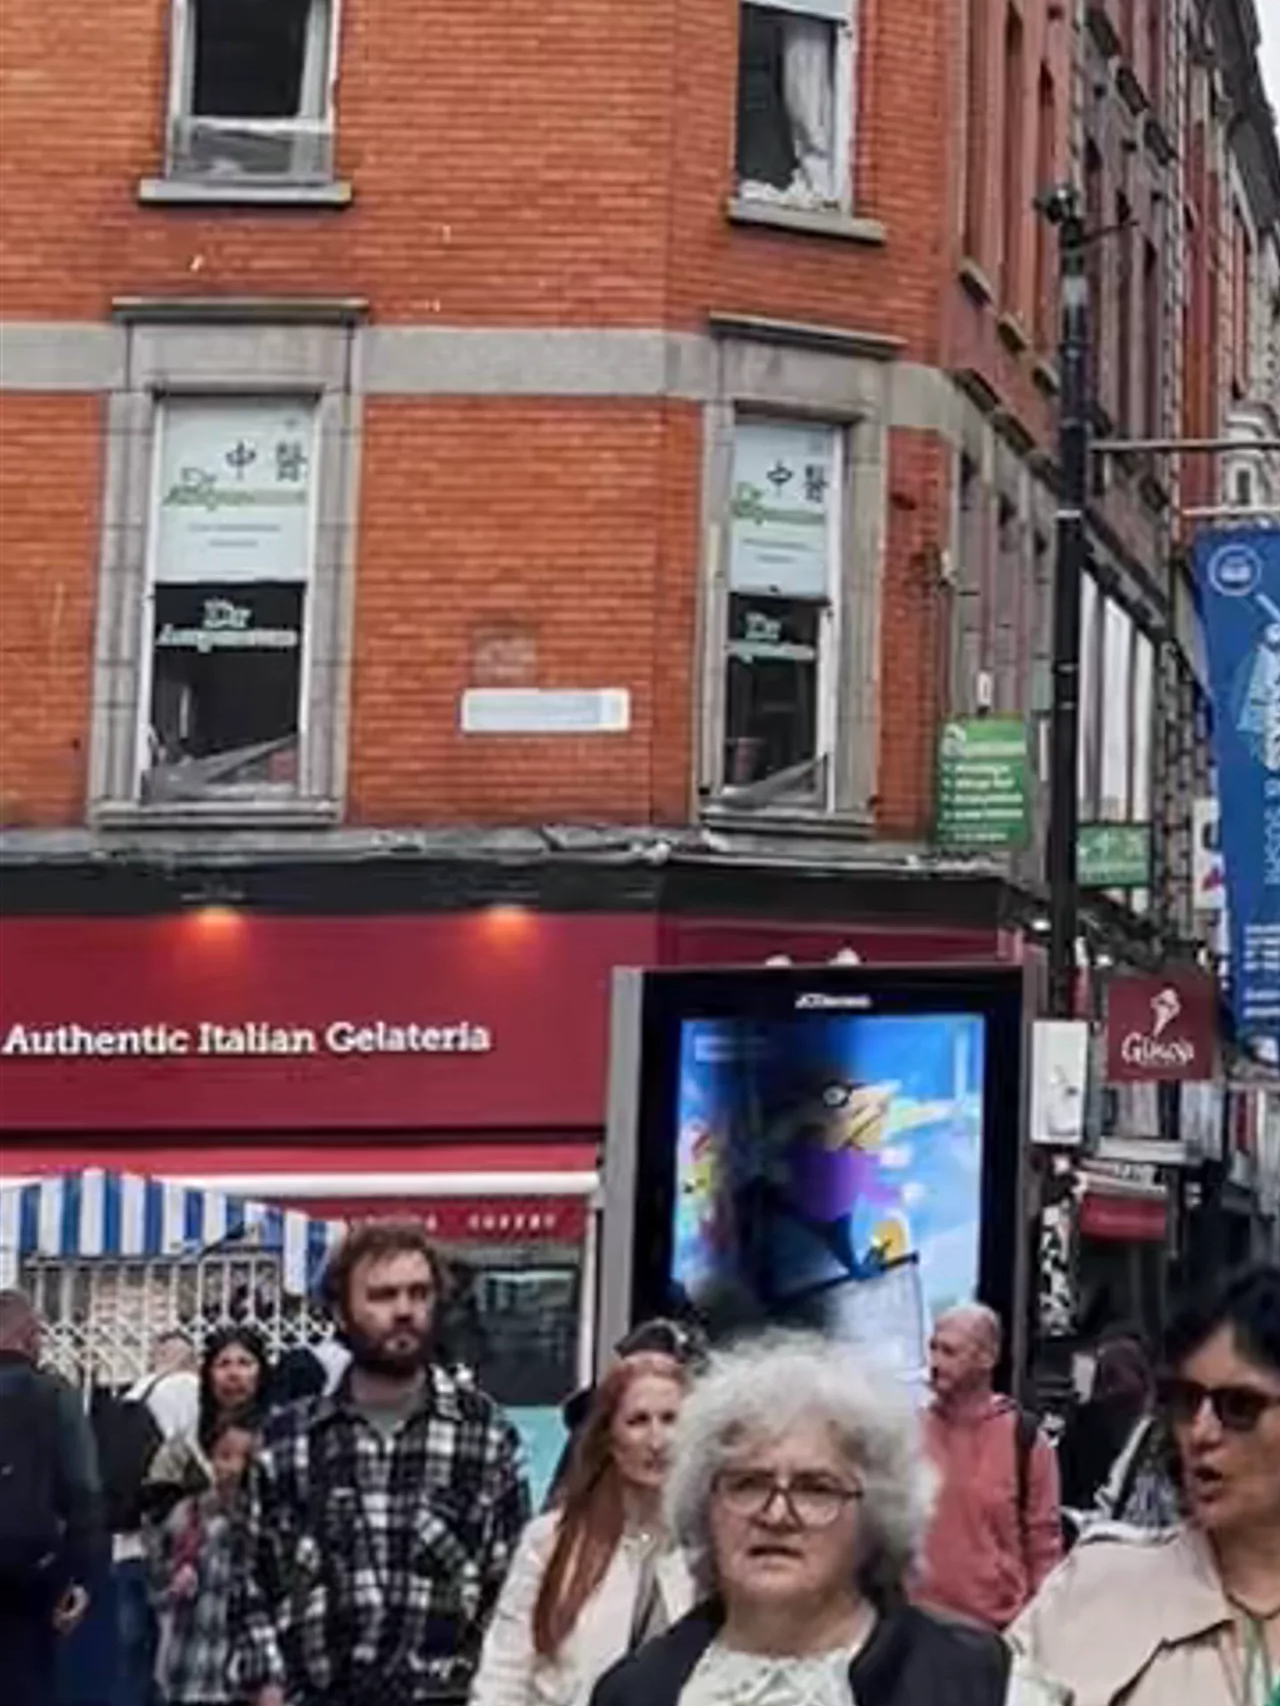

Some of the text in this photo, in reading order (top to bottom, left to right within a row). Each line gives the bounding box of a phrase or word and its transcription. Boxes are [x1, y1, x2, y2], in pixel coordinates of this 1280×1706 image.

[2, 1021, 490, 1056] Authentic Italian Gelateria
